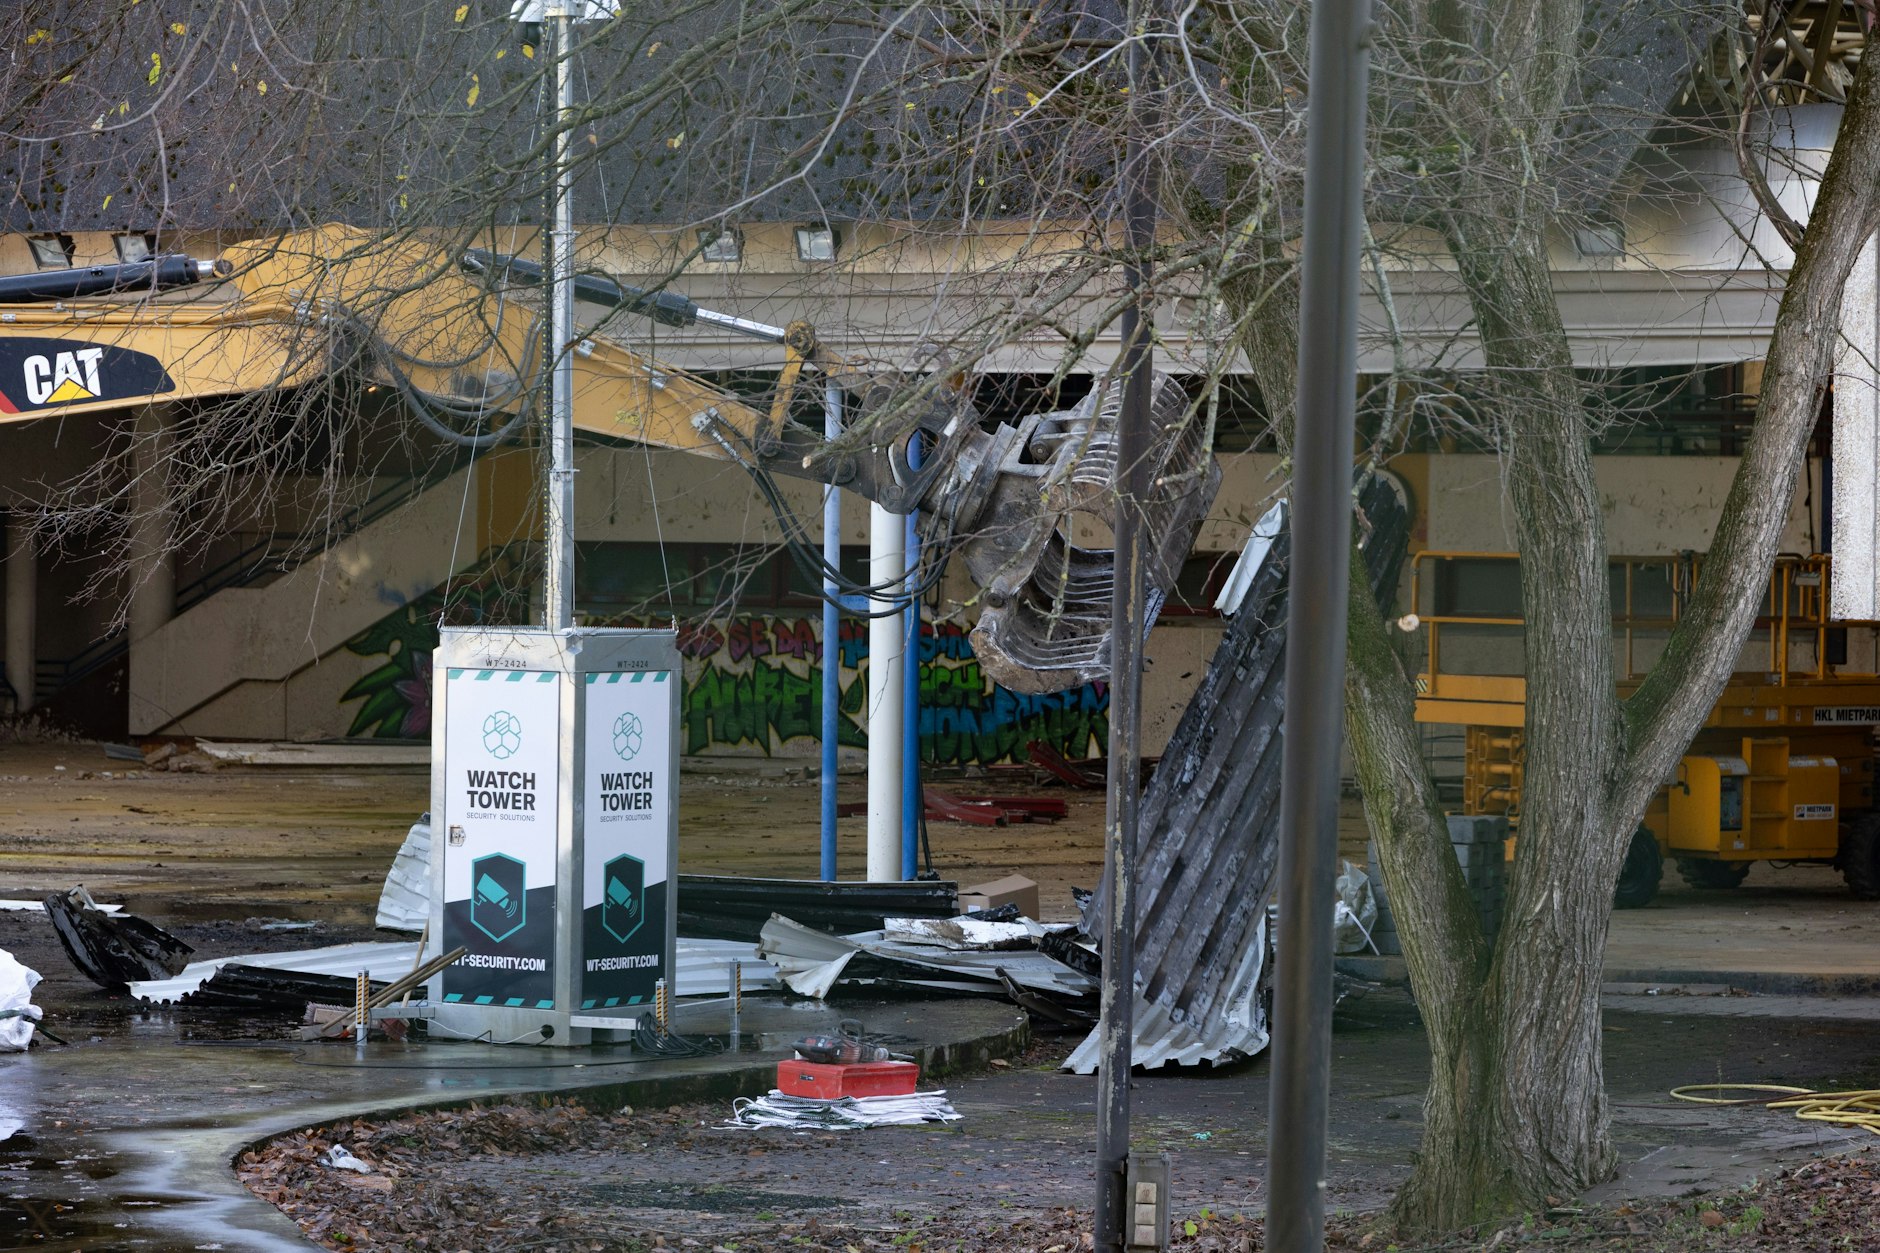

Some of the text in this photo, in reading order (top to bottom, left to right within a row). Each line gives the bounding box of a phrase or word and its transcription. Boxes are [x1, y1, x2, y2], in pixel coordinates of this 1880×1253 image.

[23, 347, 103, 404] CAT
[486, 659, 527, 668] WT-2424
[617, 660, 649, 669] WT-2424
[1815, 709, 1834, 721] HKL
[467, 770, 536, 790] WATCH
[601, 771, 653, 791] WATCH
[466, 791, 536, 811] TOWER
[600, 792, 653, 811] TOWER
[466, 812, 536, 822] SECURITY SOLUTIONS
[600, 814, 652, 823] SECURITY SOLUTIONS
[586, 954, 659, 972] WT-SECURITY.COM
